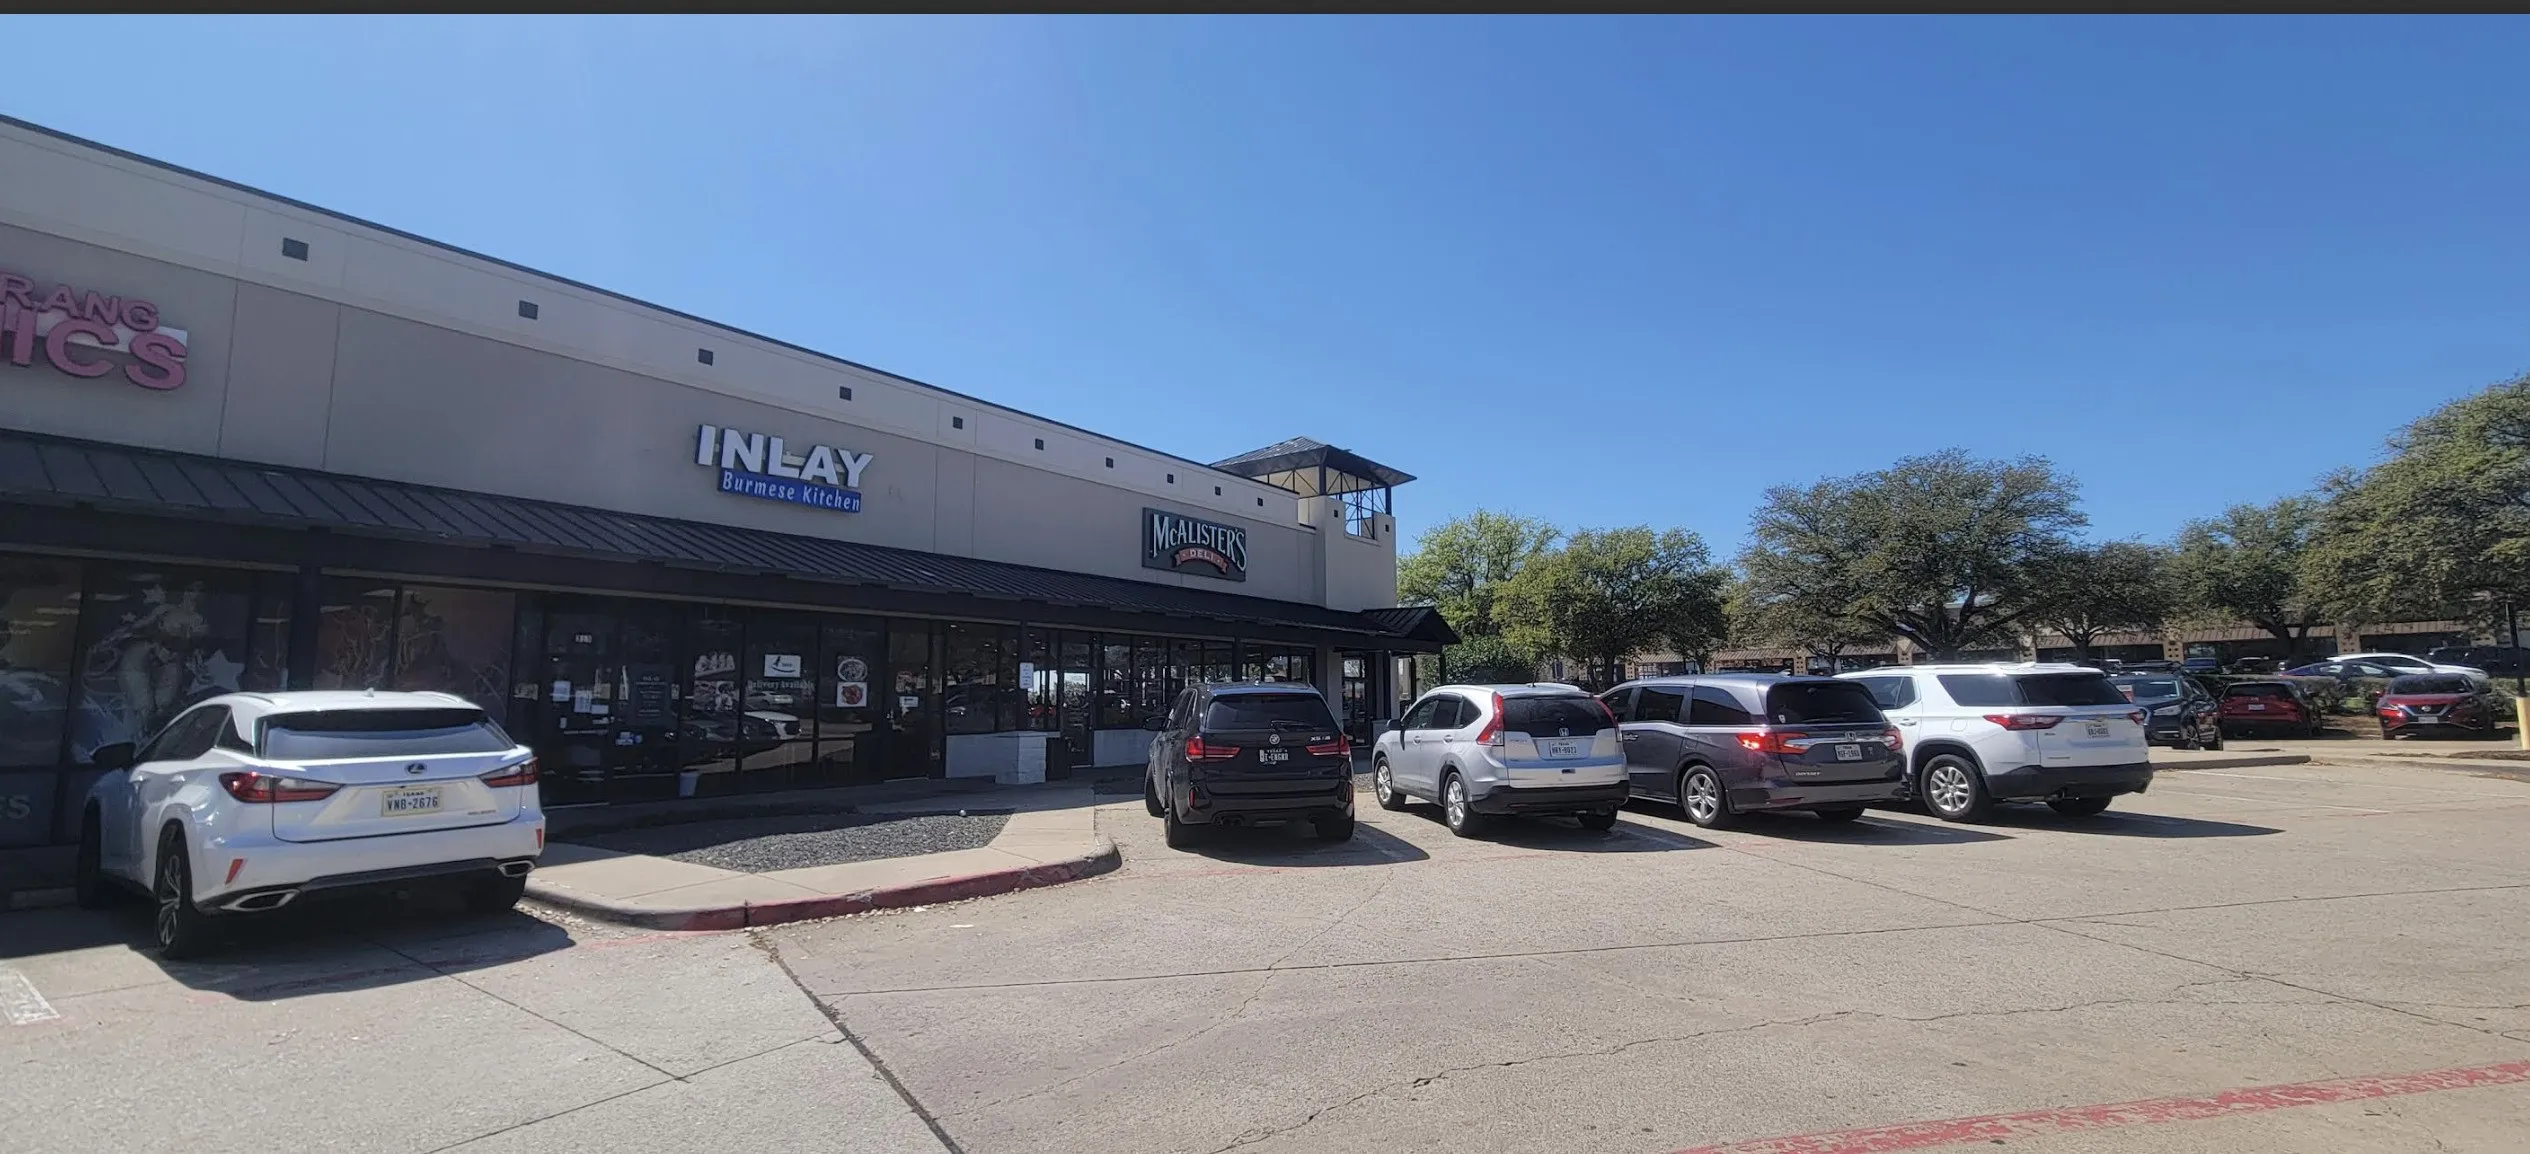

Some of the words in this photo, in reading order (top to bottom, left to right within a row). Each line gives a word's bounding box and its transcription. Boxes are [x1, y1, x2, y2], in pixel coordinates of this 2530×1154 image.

[0, 304, 187, 390] ICS
[698, 424, 874, 488] INLAY
[722, 470, 795, 500] Burmese
[802, 485, 860, 511] Kitchen
[1189, 549, 1214, 560] DELI
